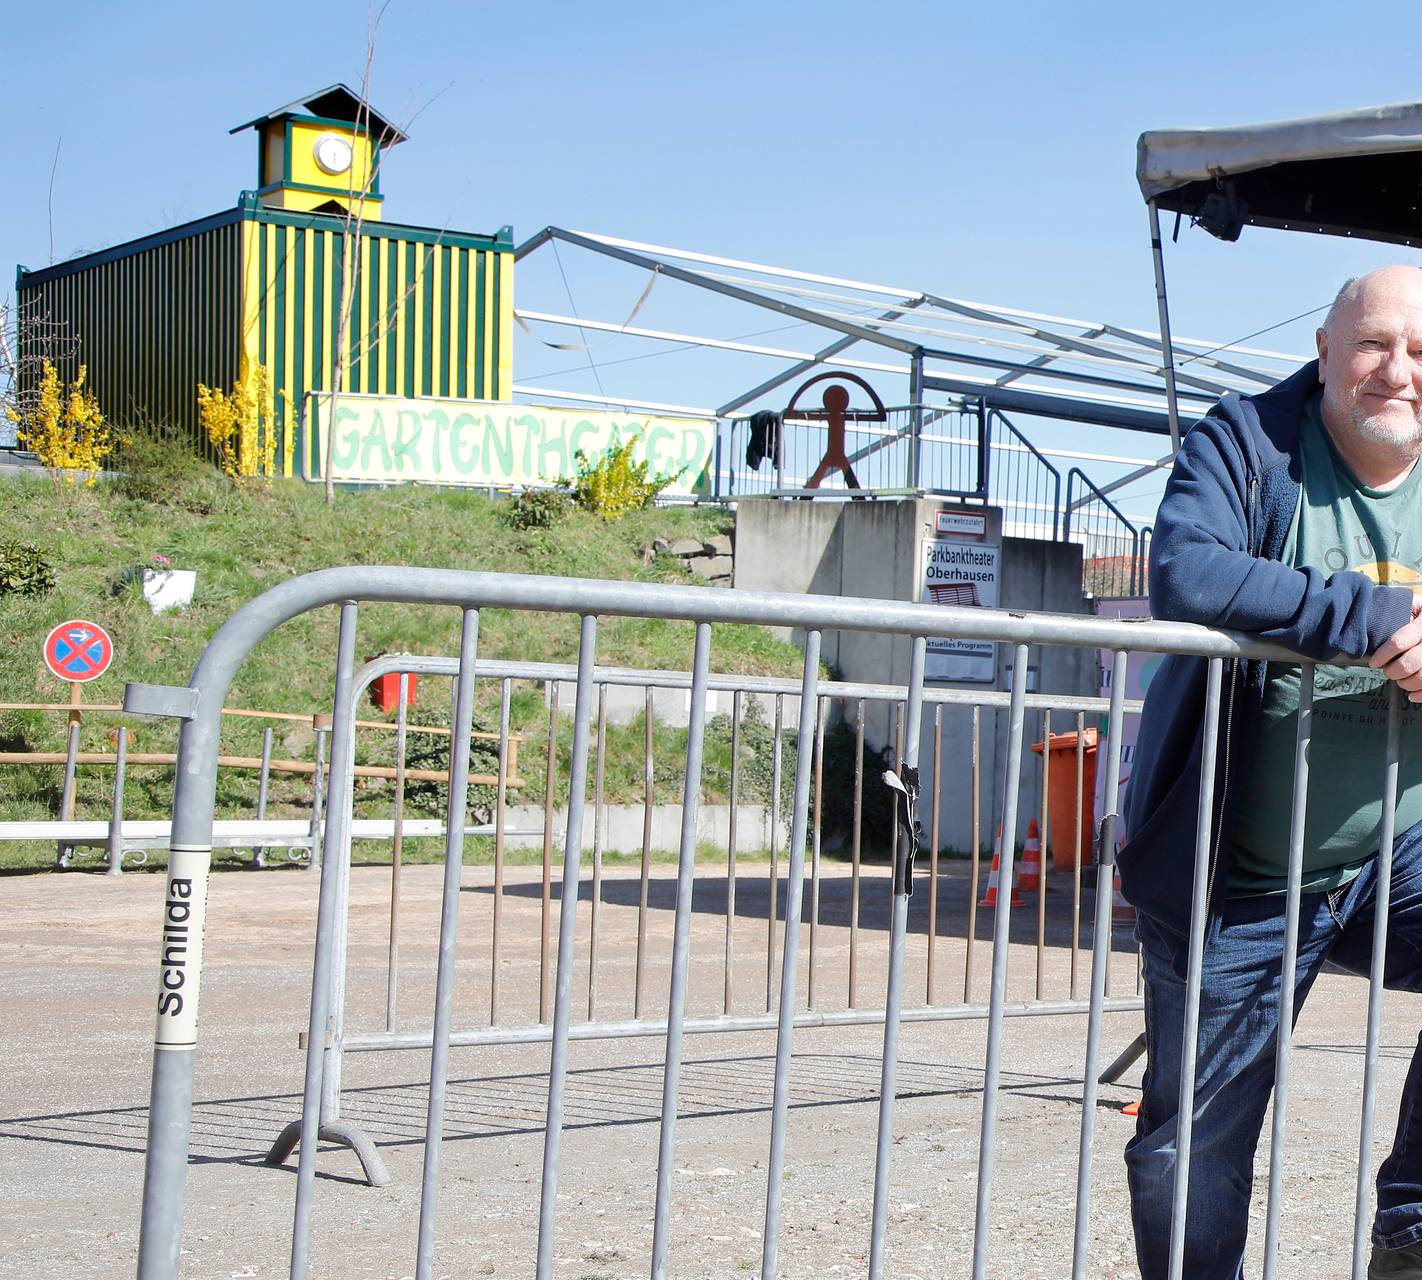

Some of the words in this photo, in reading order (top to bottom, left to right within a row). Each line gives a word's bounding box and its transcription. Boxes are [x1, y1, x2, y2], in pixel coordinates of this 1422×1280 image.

[926, 546, 995, 567] Parkbanktheater
[926, 566, 994, 582] Oberhausen
[926, 640, 955, 649] ktuelles
[957, 641, 992, 651] Programm
[158, 877, 193, 1017] Schilda
